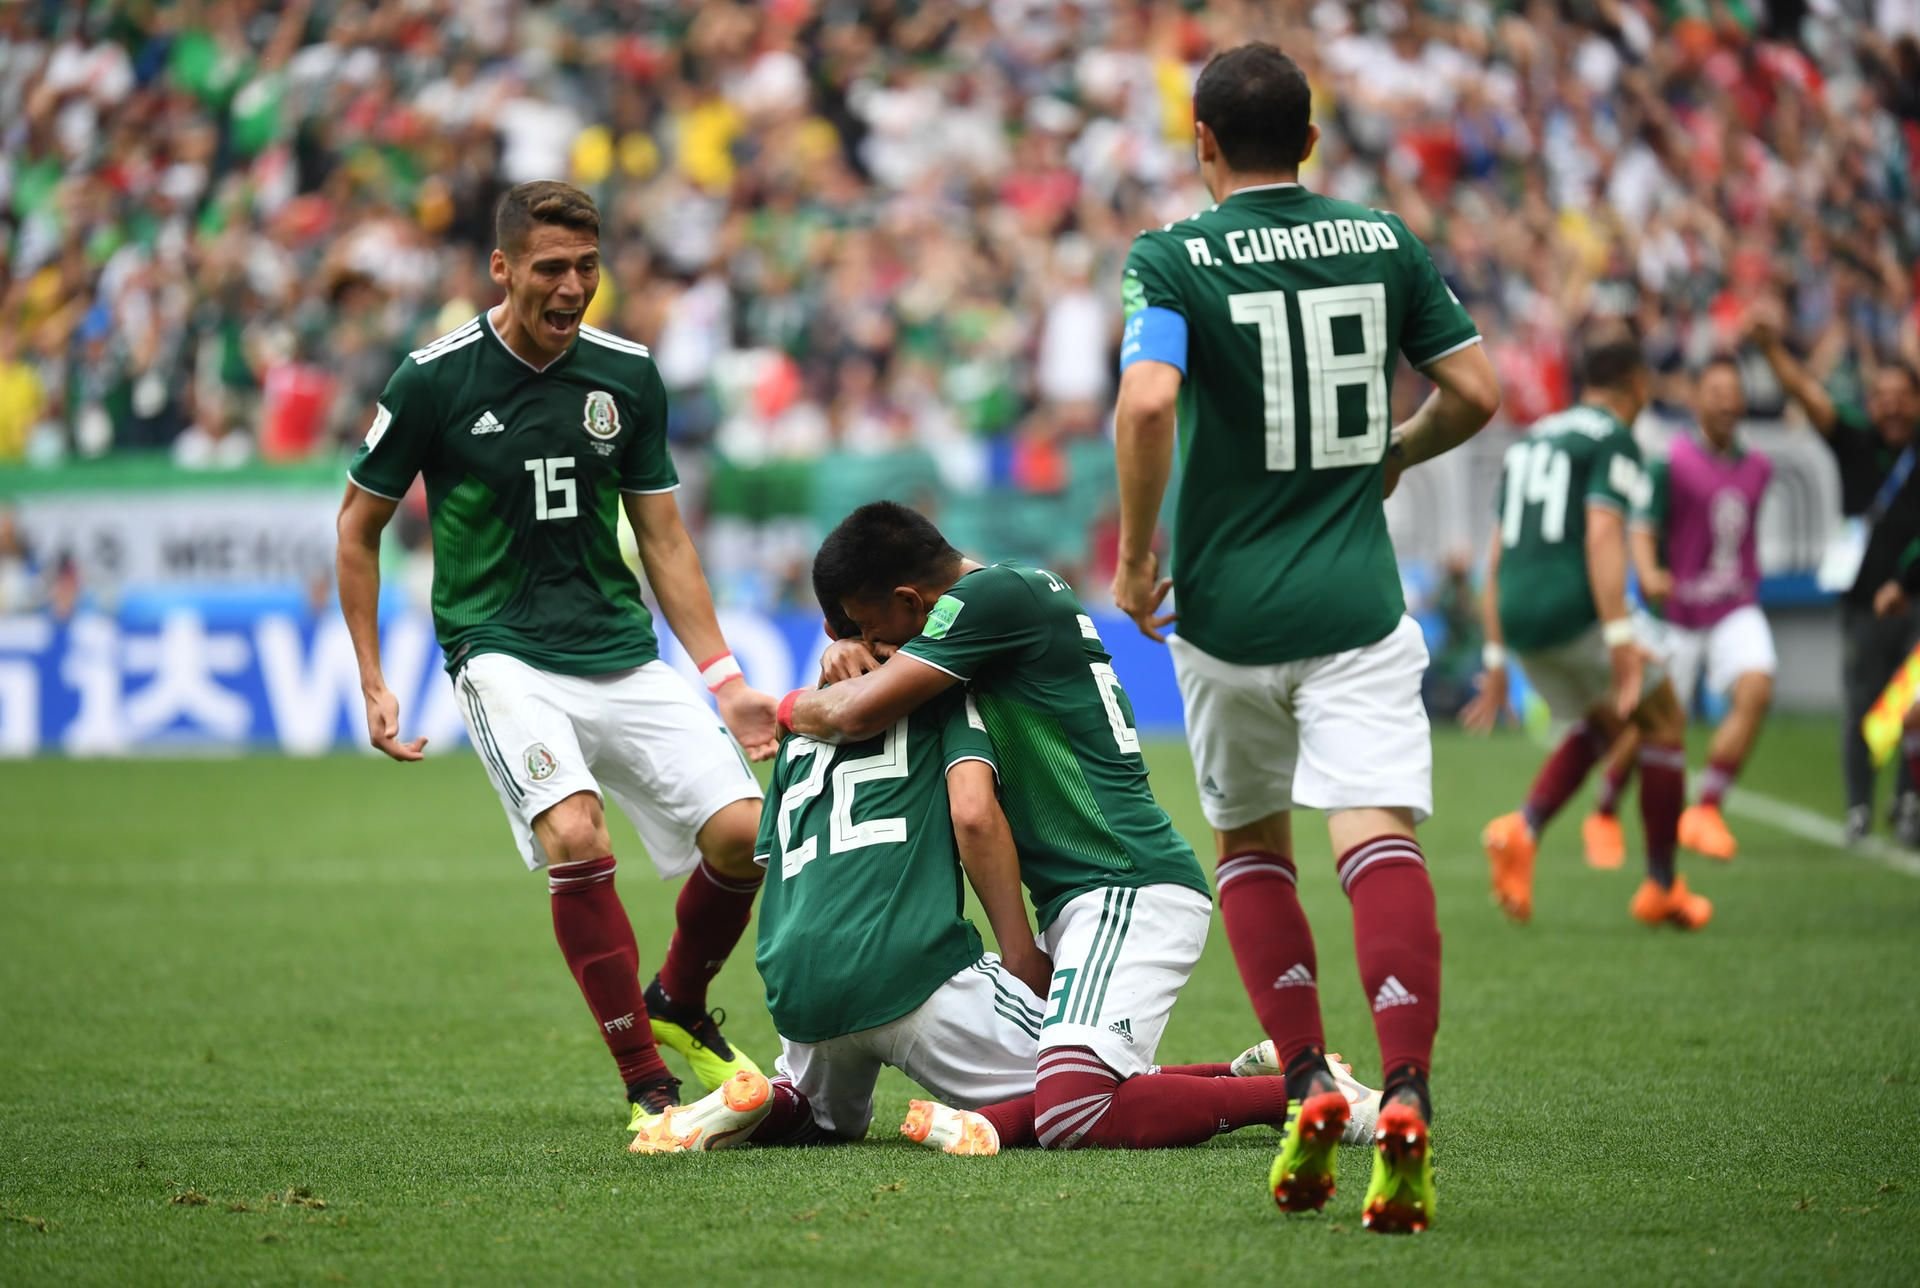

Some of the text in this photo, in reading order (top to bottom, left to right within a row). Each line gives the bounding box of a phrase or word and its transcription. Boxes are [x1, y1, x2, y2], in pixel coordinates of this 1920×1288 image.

[1184, 219, 1399, 267] A. GUARDADO
[1228, 282, 1388, 471] 18
[524, 456, 578, 521] 15
[1504, 440, 1571, 548] 14
[0, 607, 252, 758] 达
[777, 714, 909, 882] 22
[604, 1012, 636, 1034] FMF
[1042, 967, 1077, 1030] 3
[1108, 1024, 1134, 1044] adidas
